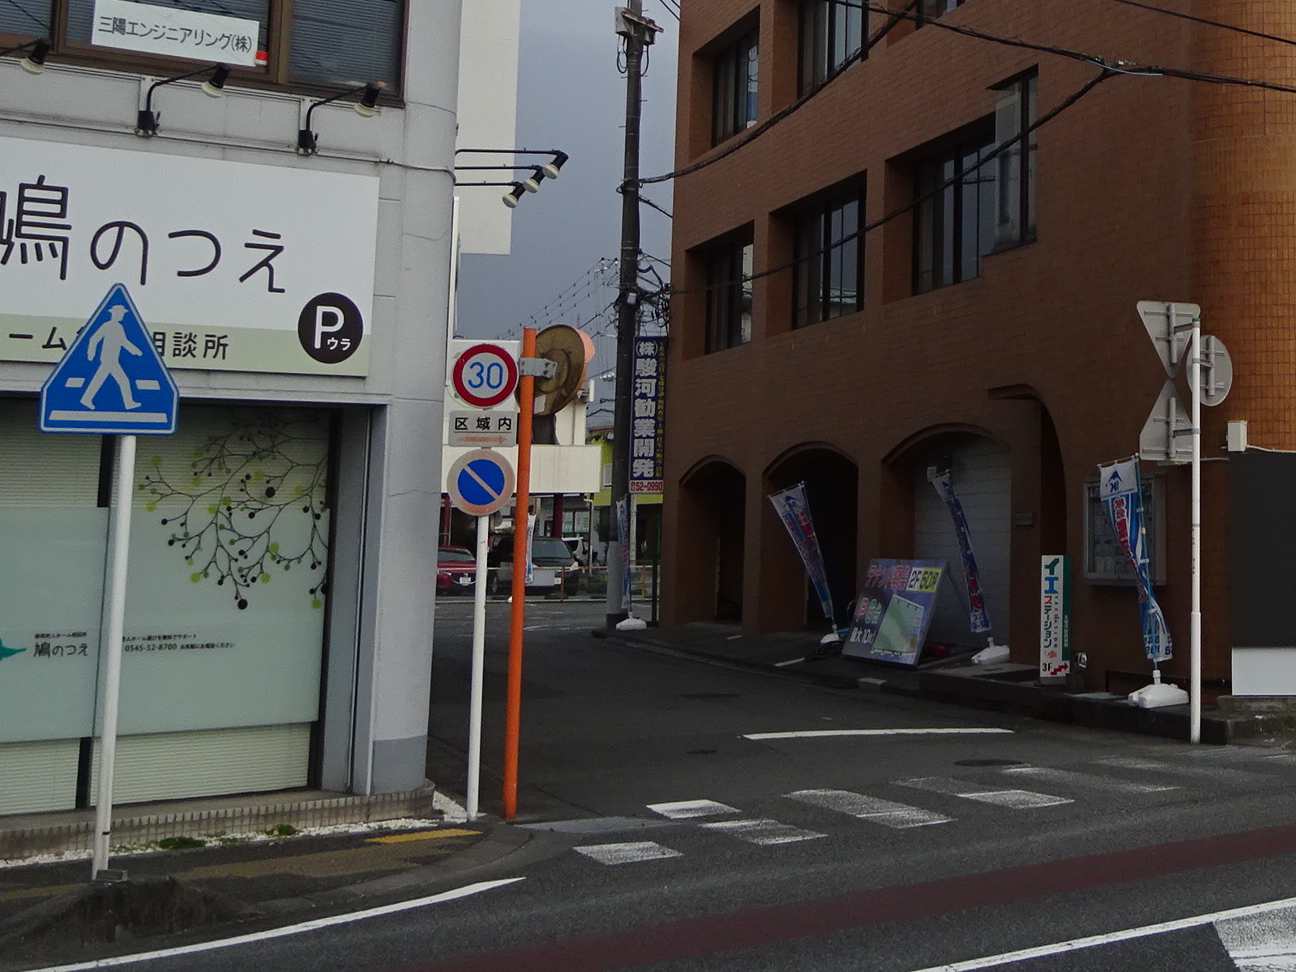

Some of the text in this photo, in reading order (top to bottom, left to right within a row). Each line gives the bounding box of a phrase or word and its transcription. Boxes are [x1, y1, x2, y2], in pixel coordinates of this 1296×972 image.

[314, 305, 345, 349] P
[468, 361, 503, 389] 30
[455, 416, 511, 430] 区域内
[1044, 558, 1060, 648] イエステーション
[33, 641, 88, 658] 鳩のつえ
